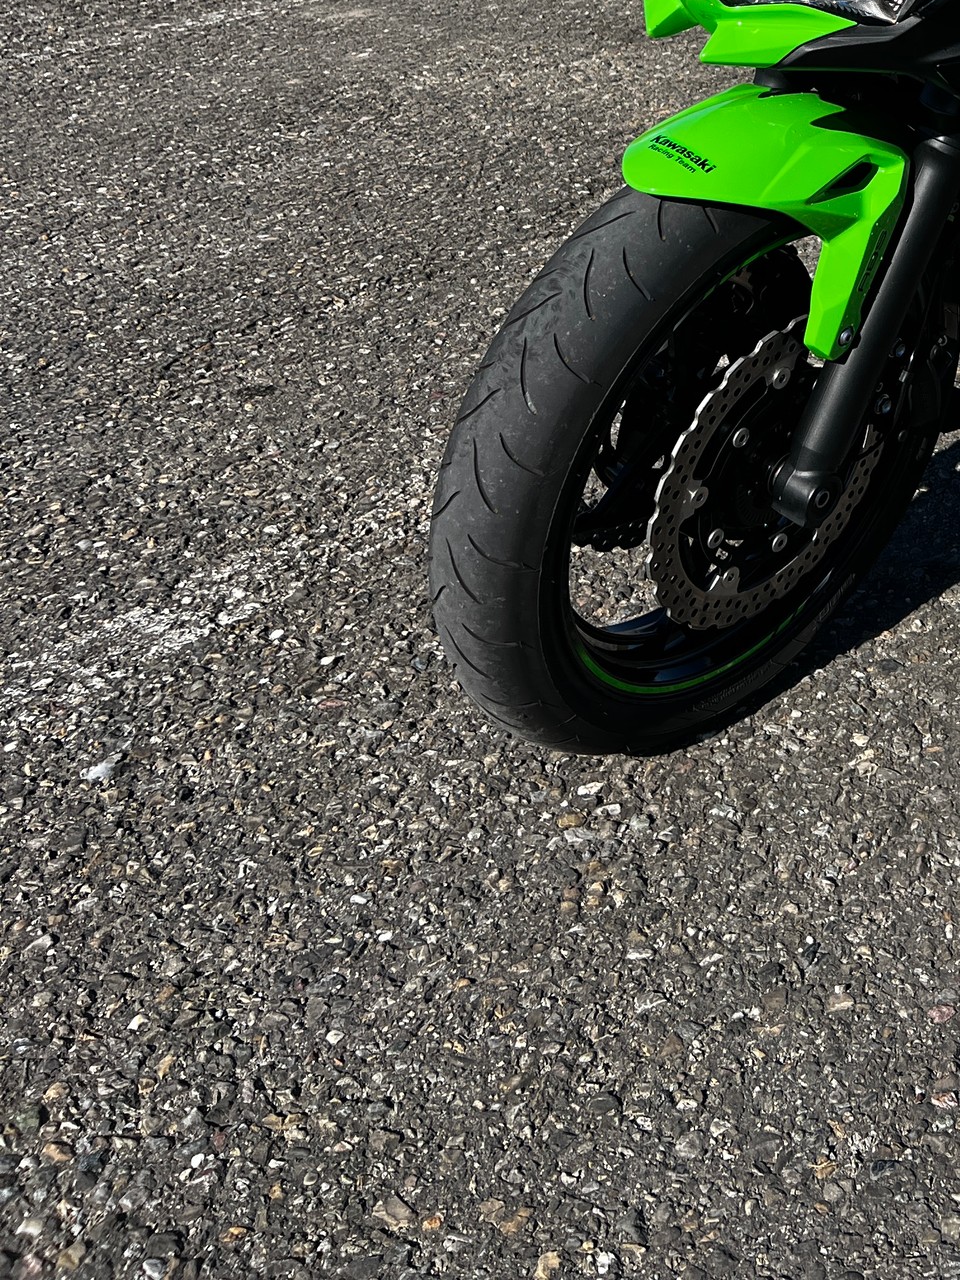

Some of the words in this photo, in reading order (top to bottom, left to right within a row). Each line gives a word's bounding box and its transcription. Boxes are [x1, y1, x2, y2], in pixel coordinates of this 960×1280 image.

[647, 144, 675, 160] Racing
[674, 155, 697, 174] Team
[650, 134, 717, 174] Kawasaki
